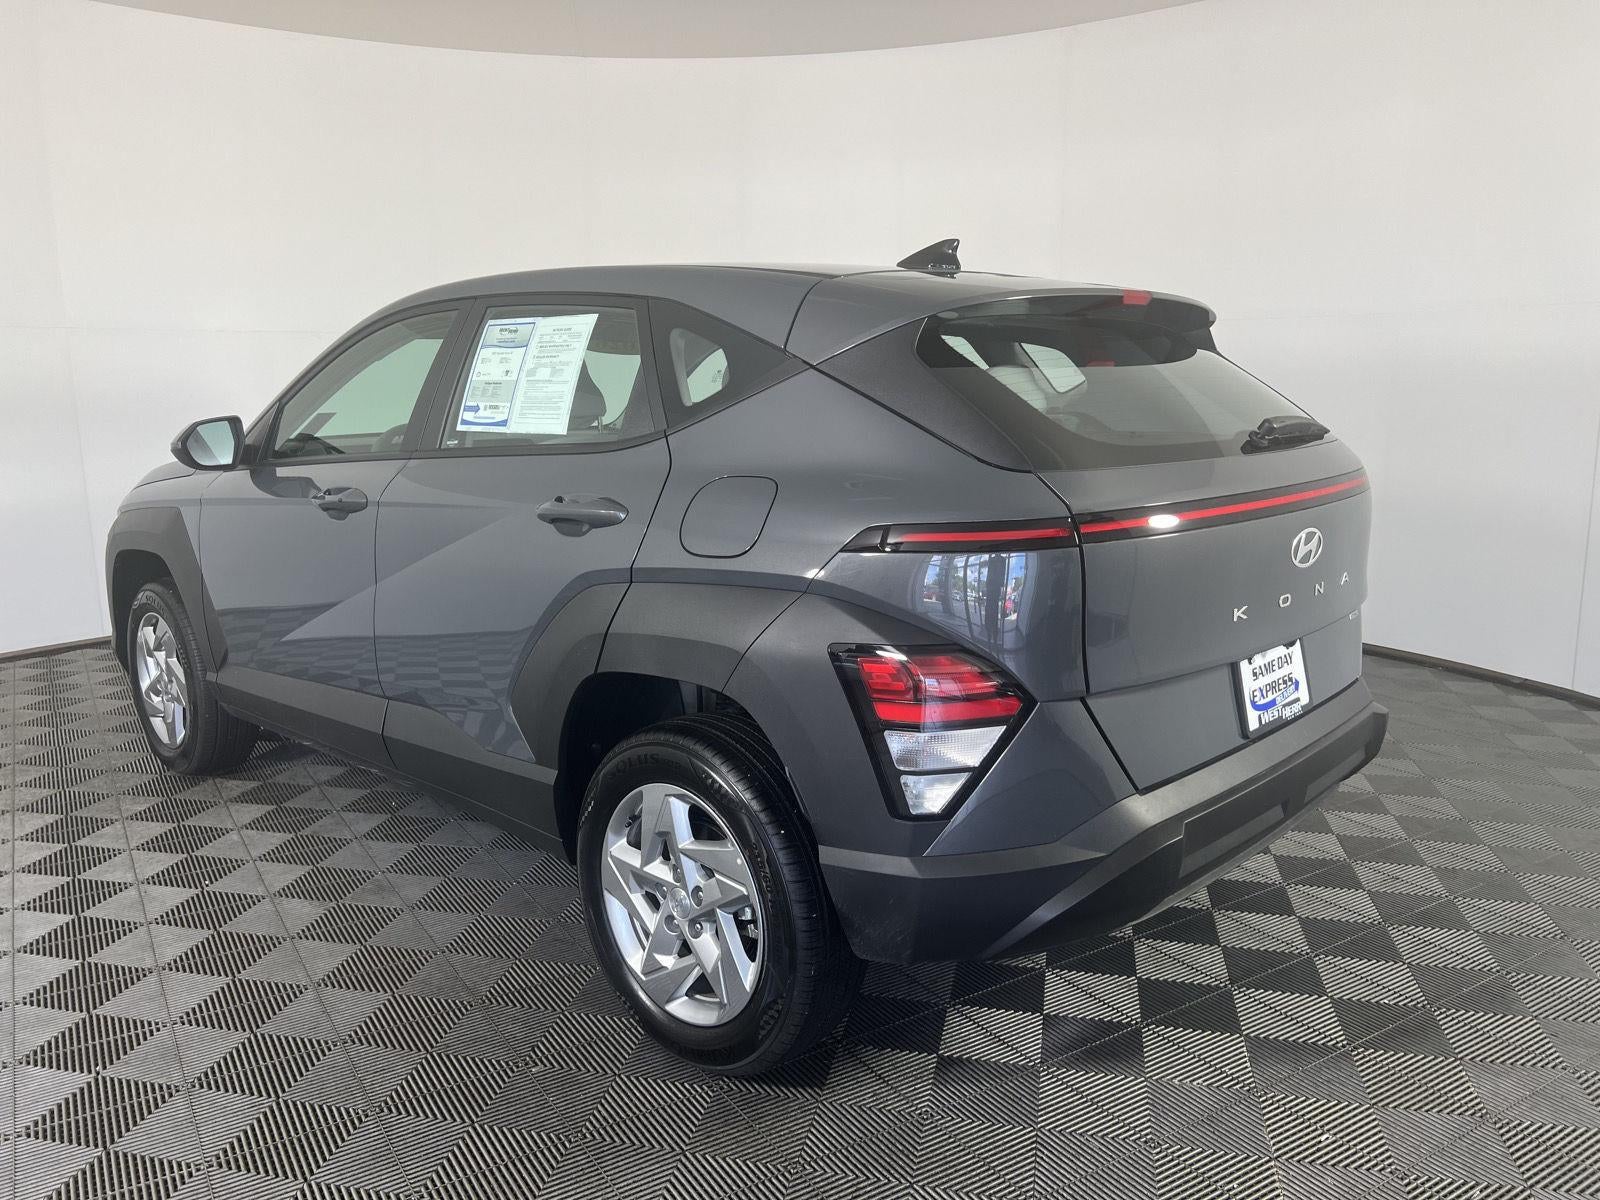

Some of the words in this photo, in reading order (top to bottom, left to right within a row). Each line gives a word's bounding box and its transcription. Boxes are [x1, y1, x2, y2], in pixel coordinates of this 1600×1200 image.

[1233, 571, 1349, 622] KONA
[1252, 659, 1276, 682] SAME
[1277, 651, 1294, 670] DAY
[1252, 672, 1294, 704] EXPRESS
[1260, 706, 1283, 725] WEST
[1282, 702, 1302, 719] HERR
